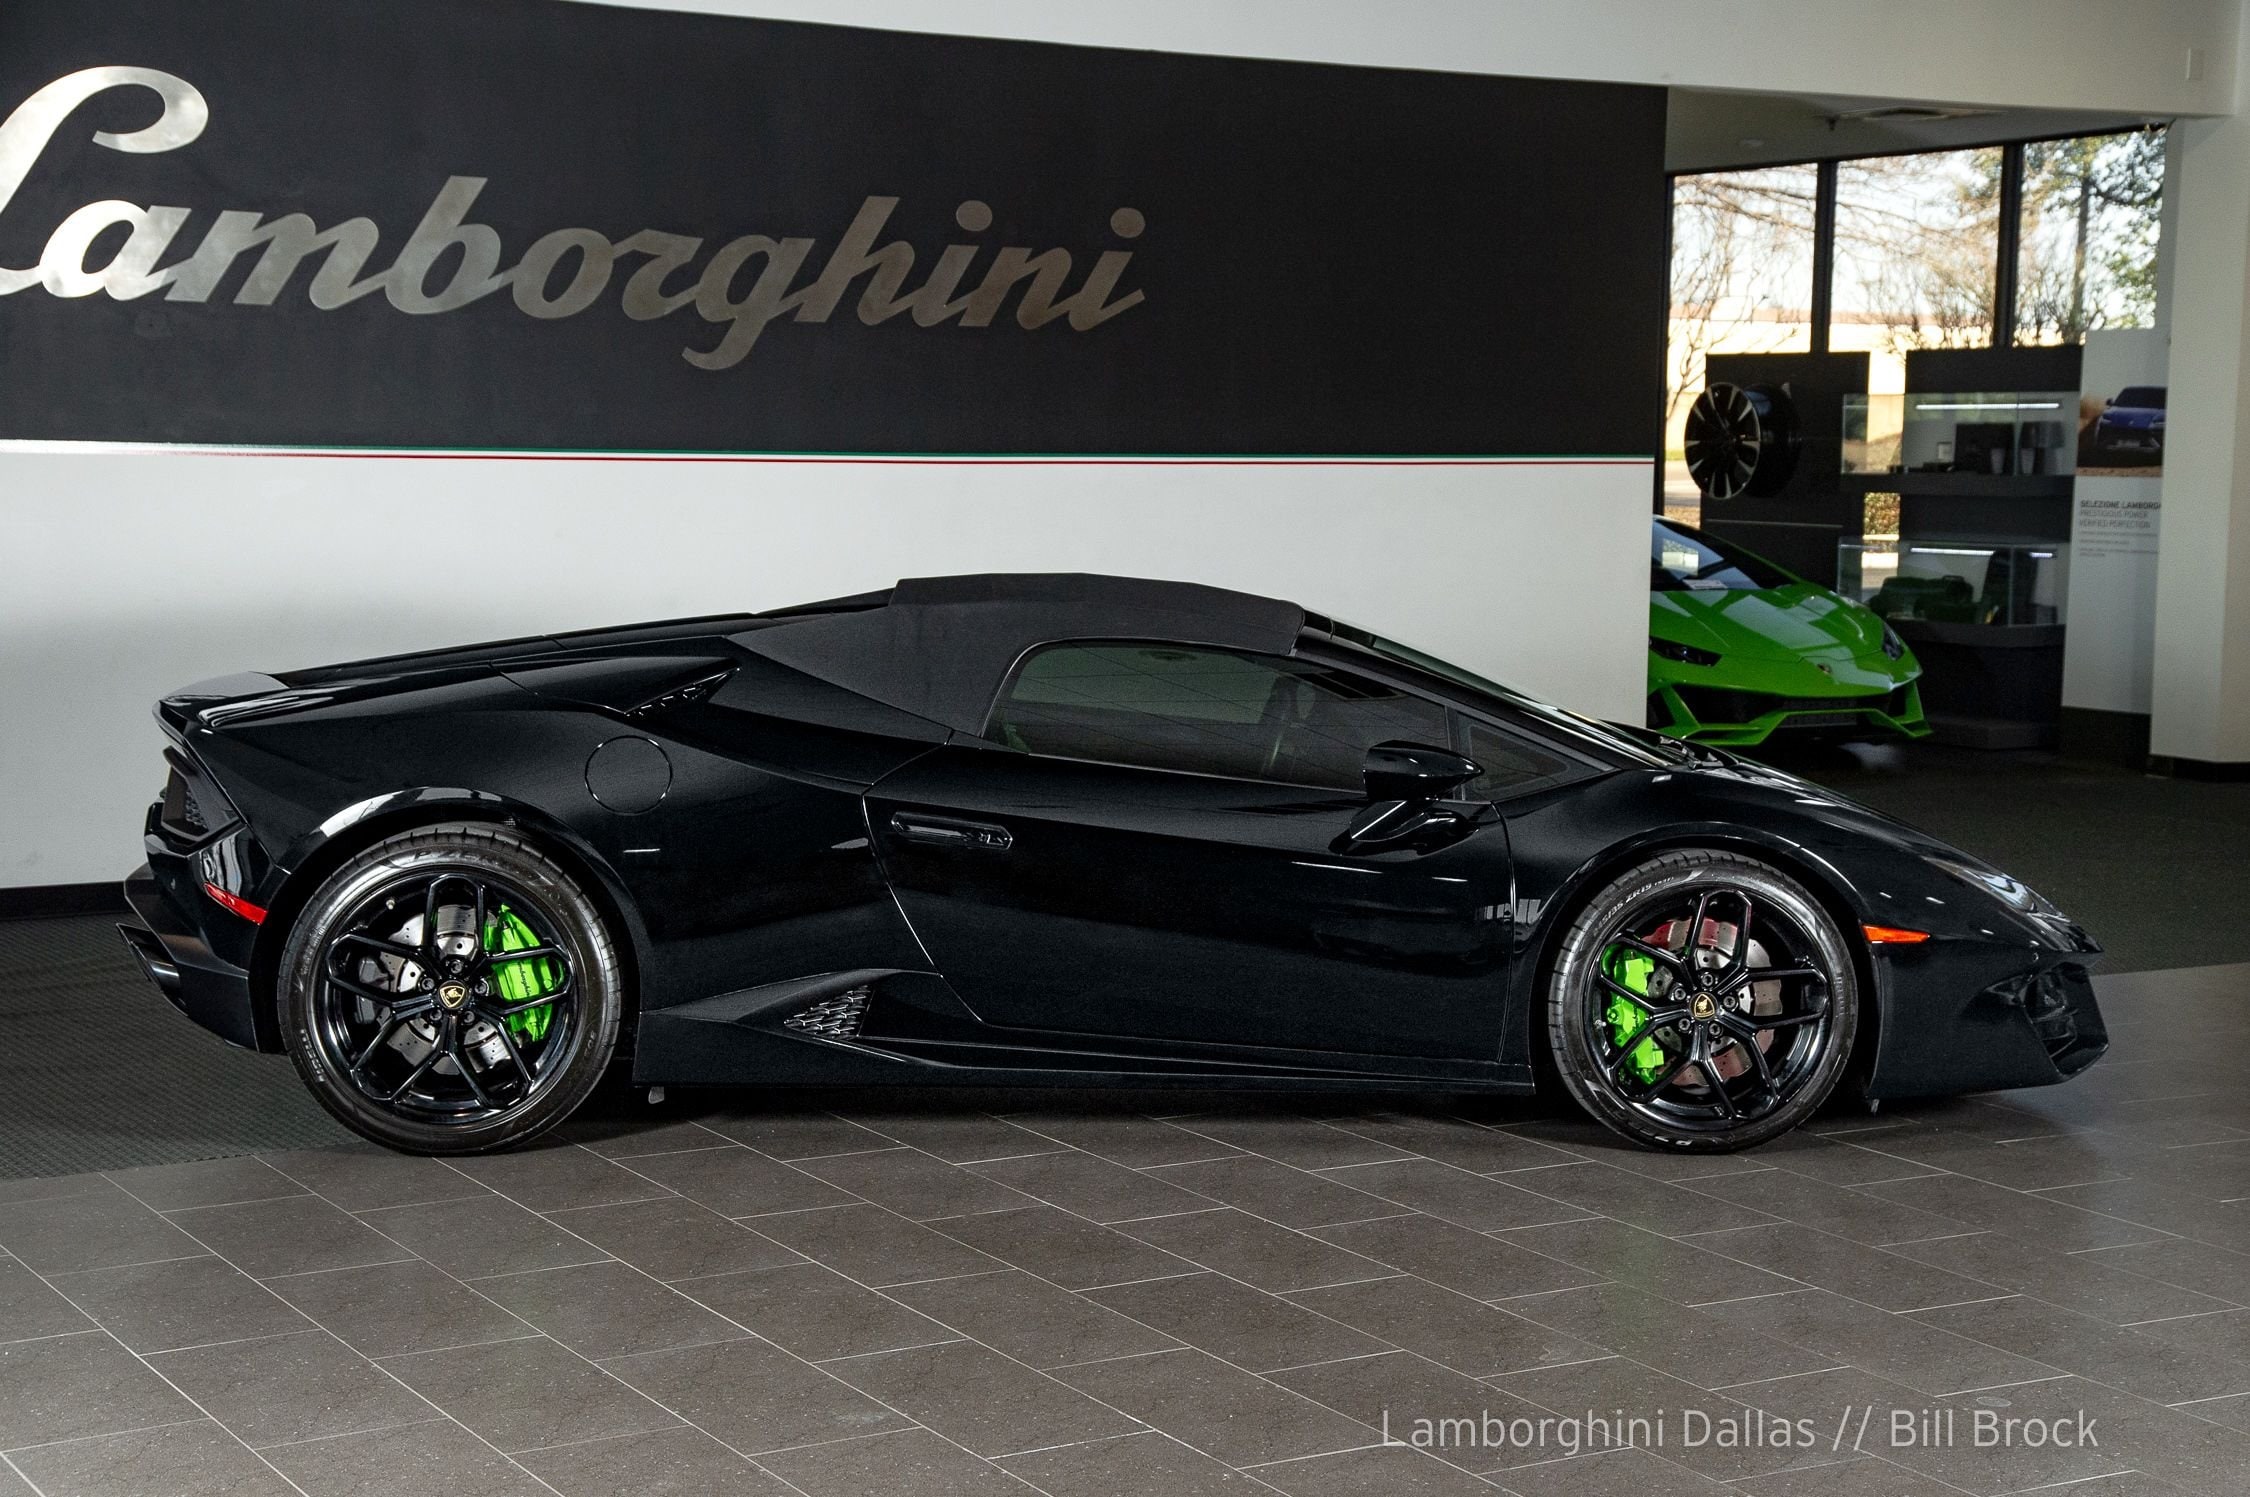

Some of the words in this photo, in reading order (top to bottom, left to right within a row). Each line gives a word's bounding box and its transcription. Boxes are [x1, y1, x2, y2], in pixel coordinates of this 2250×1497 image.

[0, 65, 1146, 371] Lamborghini
[2081, 500, 2120, 509] SELEZIONE
[2124, 511, 2149, 519] POWER
